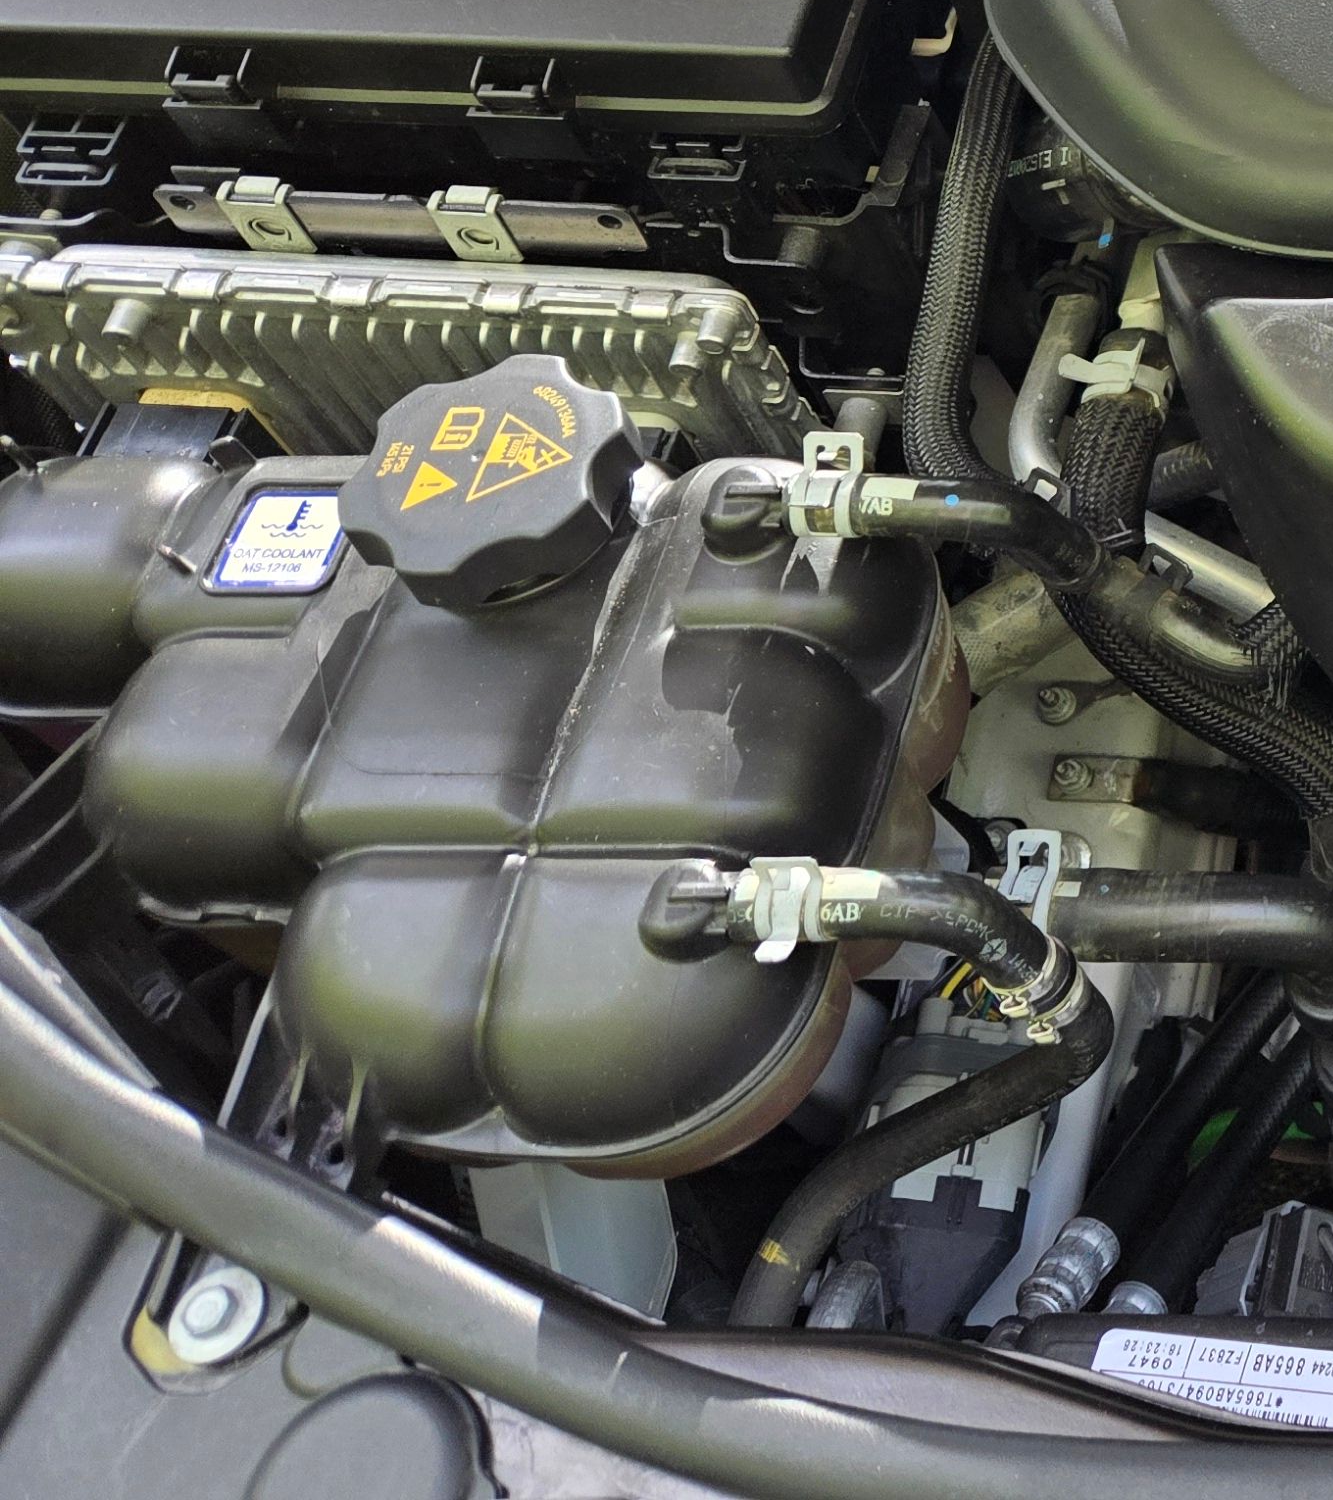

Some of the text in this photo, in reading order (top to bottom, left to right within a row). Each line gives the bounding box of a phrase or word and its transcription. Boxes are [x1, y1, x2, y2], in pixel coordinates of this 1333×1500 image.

[233, 548, 325, 559] OAT COOLANT
[1127, 1354, 1173, 1370] 0947
[1198, 1346, 1244, 1366] FZ837
[1252, 1353, 1306, 1377] 865AB
